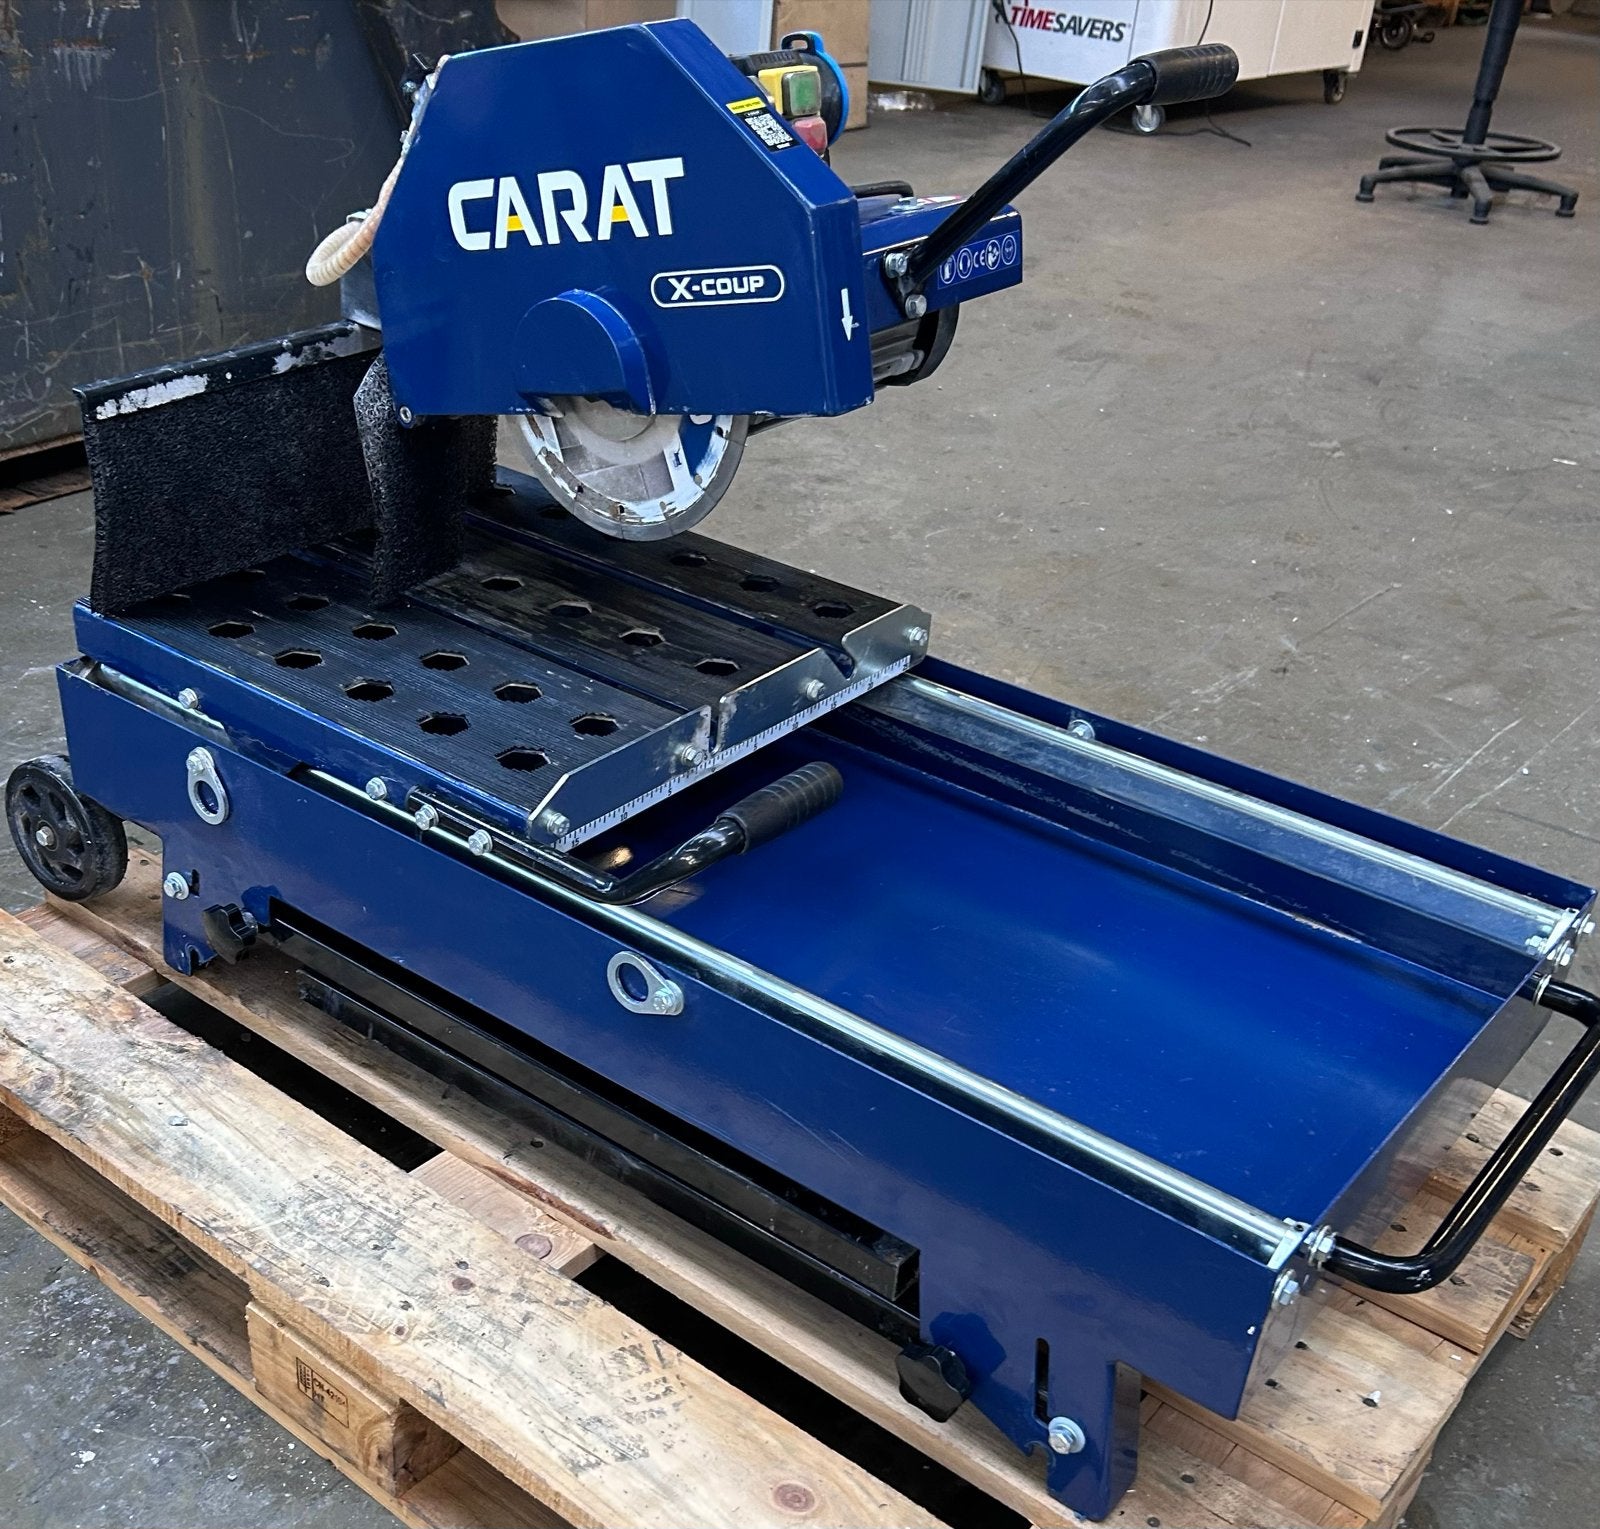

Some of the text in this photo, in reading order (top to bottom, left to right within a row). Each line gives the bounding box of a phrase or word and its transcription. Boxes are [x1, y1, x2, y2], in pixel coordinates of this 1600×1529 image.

[1010, 6, 1127, 42] TIMESAVERS
[448, 157, 684, 251] CARAT
[668, 275, 764, 301] X-COUP
